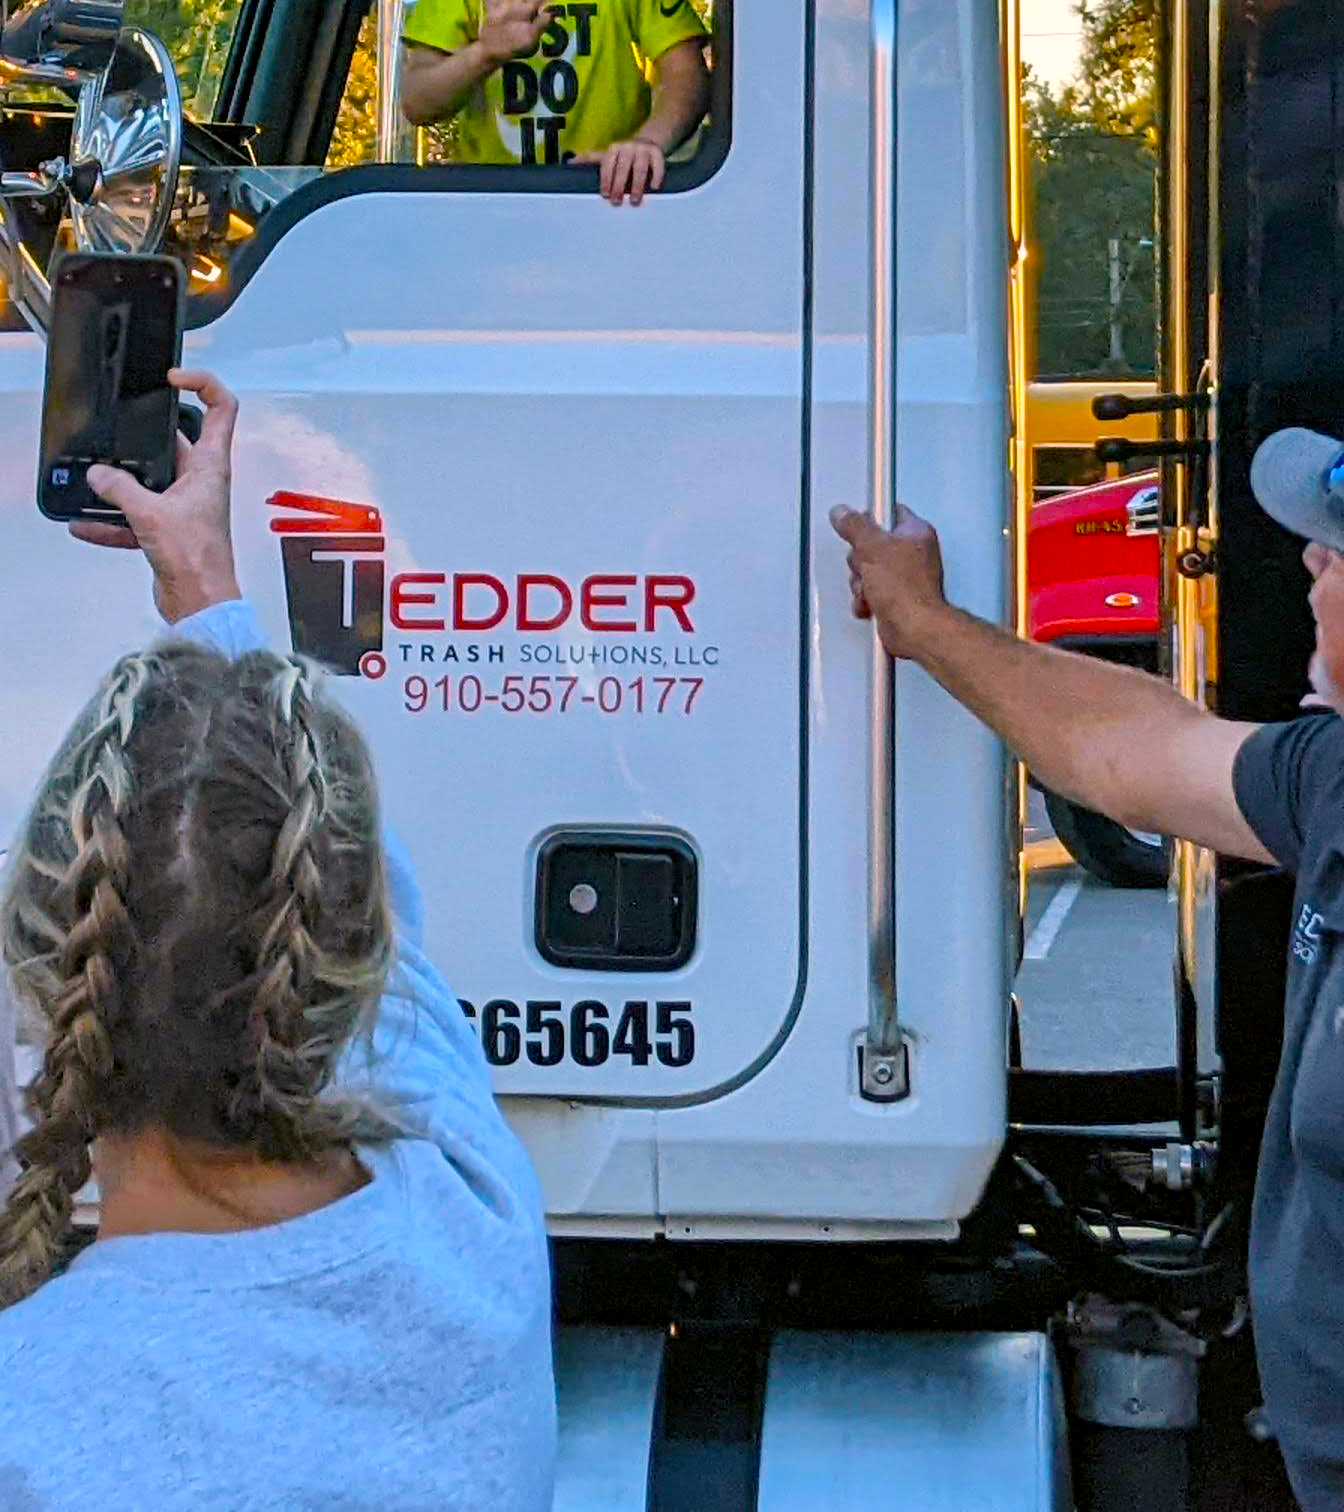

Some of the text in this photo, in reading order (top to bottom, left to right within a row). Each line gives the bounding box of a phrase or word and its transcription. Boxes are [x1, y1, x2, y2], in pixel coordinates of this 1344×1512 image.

[503, 59, 579, 115] DO
[311, 550, 696, 632] TEDDER
[399, 644, 504, 663] TRASH
[674, 646, 719, 666] LLC
[404, 674, 704, 714] 910-557-0177
[457, 999, 695, 1067] 65645
